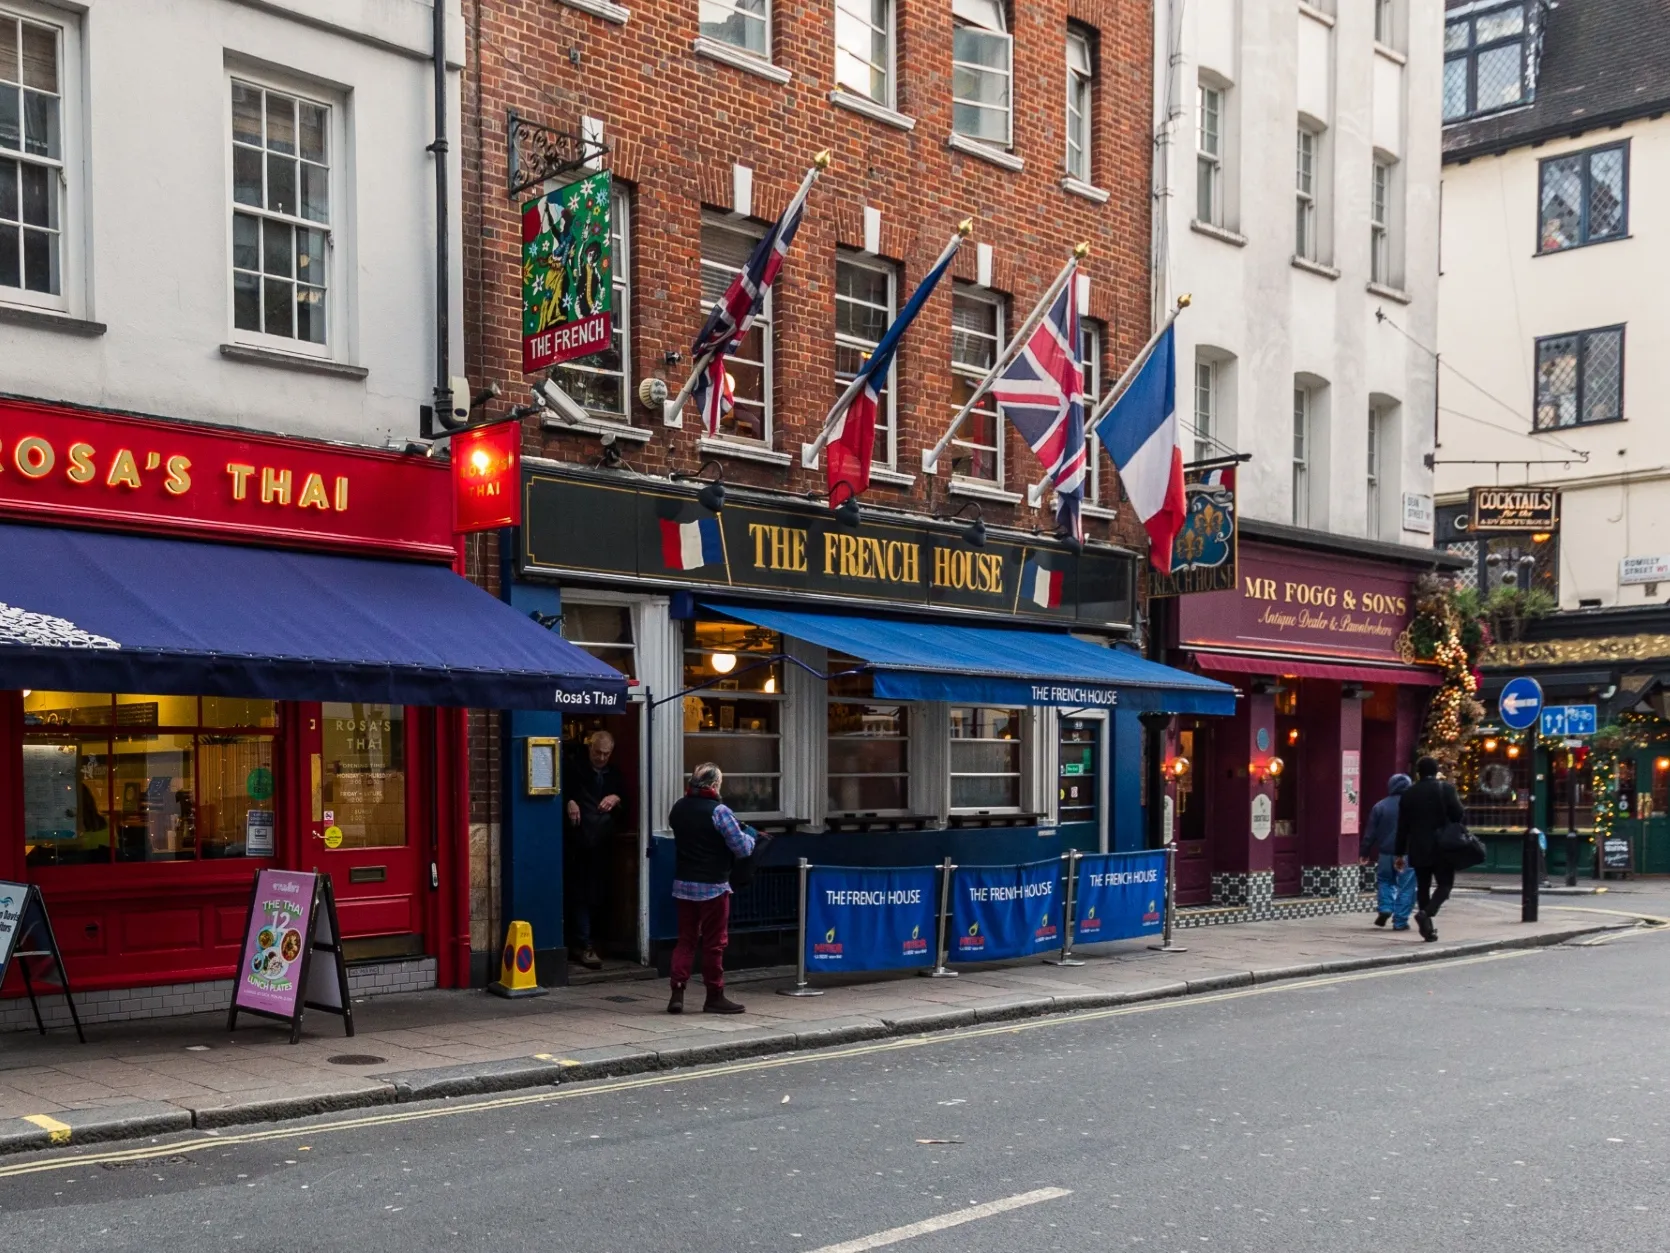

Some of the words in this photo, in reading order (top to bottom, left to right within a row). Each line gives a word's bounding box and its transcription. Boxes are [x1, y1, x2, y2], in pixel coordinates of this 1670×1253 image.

[529, 333, 552, 360] THE
[554, 318, 605, 354] FRENCH
[0, 436, 192, 495] OSA'S
[227, 463, 349, 511] THAI
[468, 481, 500, 497] THAI
[1480, 492, 1552, 510] COCKTAILS
[1407, 509, 1424, 520] STREET
[1480, 518, 1551, 526] ADVENTUROUS
[1500, 510, 1517, 518] for
[1518, 509, 1533, 517] the
[749, 523, 807, 573] THE
[823, 532, 920, 583] FRENCH
[934, 548, 1003, 593] HOUSE
[1624, 558, 1660, 567] ROMILLY
[1624, 566, 1654, 575] STREET
[1148, 570, 1192, 596] FRENCH
[1195, 564, 1234, 591] HOUSE
[1245, 577, 1277, 601] MR
[1285, 582, 1337, 608] FOGG
[1343, 590, 1357, 610] &
[1362, 593, 1407, 617] SONS
[1258, 606, 1297, 632] Antique
[1298, 608, 1328, 629] Dealer
[1329, 617, 1337, 631] &
[1339, 614, 1393, 637] Pawnbrokers
[555, 689, 590, 704] Rosa's
[593, 691, 617, 706] Thai
[1031, 685, 1048, 701] THE
[1051, 687, 1087, 703] FRENCH
[1088, 690, 1118, 705] HOUSE
[336, 720, 391, 732] ROSA'S
[347, 738, 382, 750] THAI
[1090, 874, 1103, 887] THE
[1105, 872, 1132, 887] FRENCH
[1133, 869, 1157, 884] HOUSE
[826, 890, 846, 905] THE
[847, 890, 886, 905] FRENCH
[888, 890, 921, 904] HOUSE
[969, 888, 987, 902] THE
[990, 886, 1023, 902] FRENCH
[1024, 881, 1052, 898] HOUSE
[262, 900, 281, 910] THE
[283, 900, 304, 916] THAI
[271, 911, 291, 931] 12
[247, 974, 269, 991] LUNCH
[270, 982, 293, 992] PLATES
